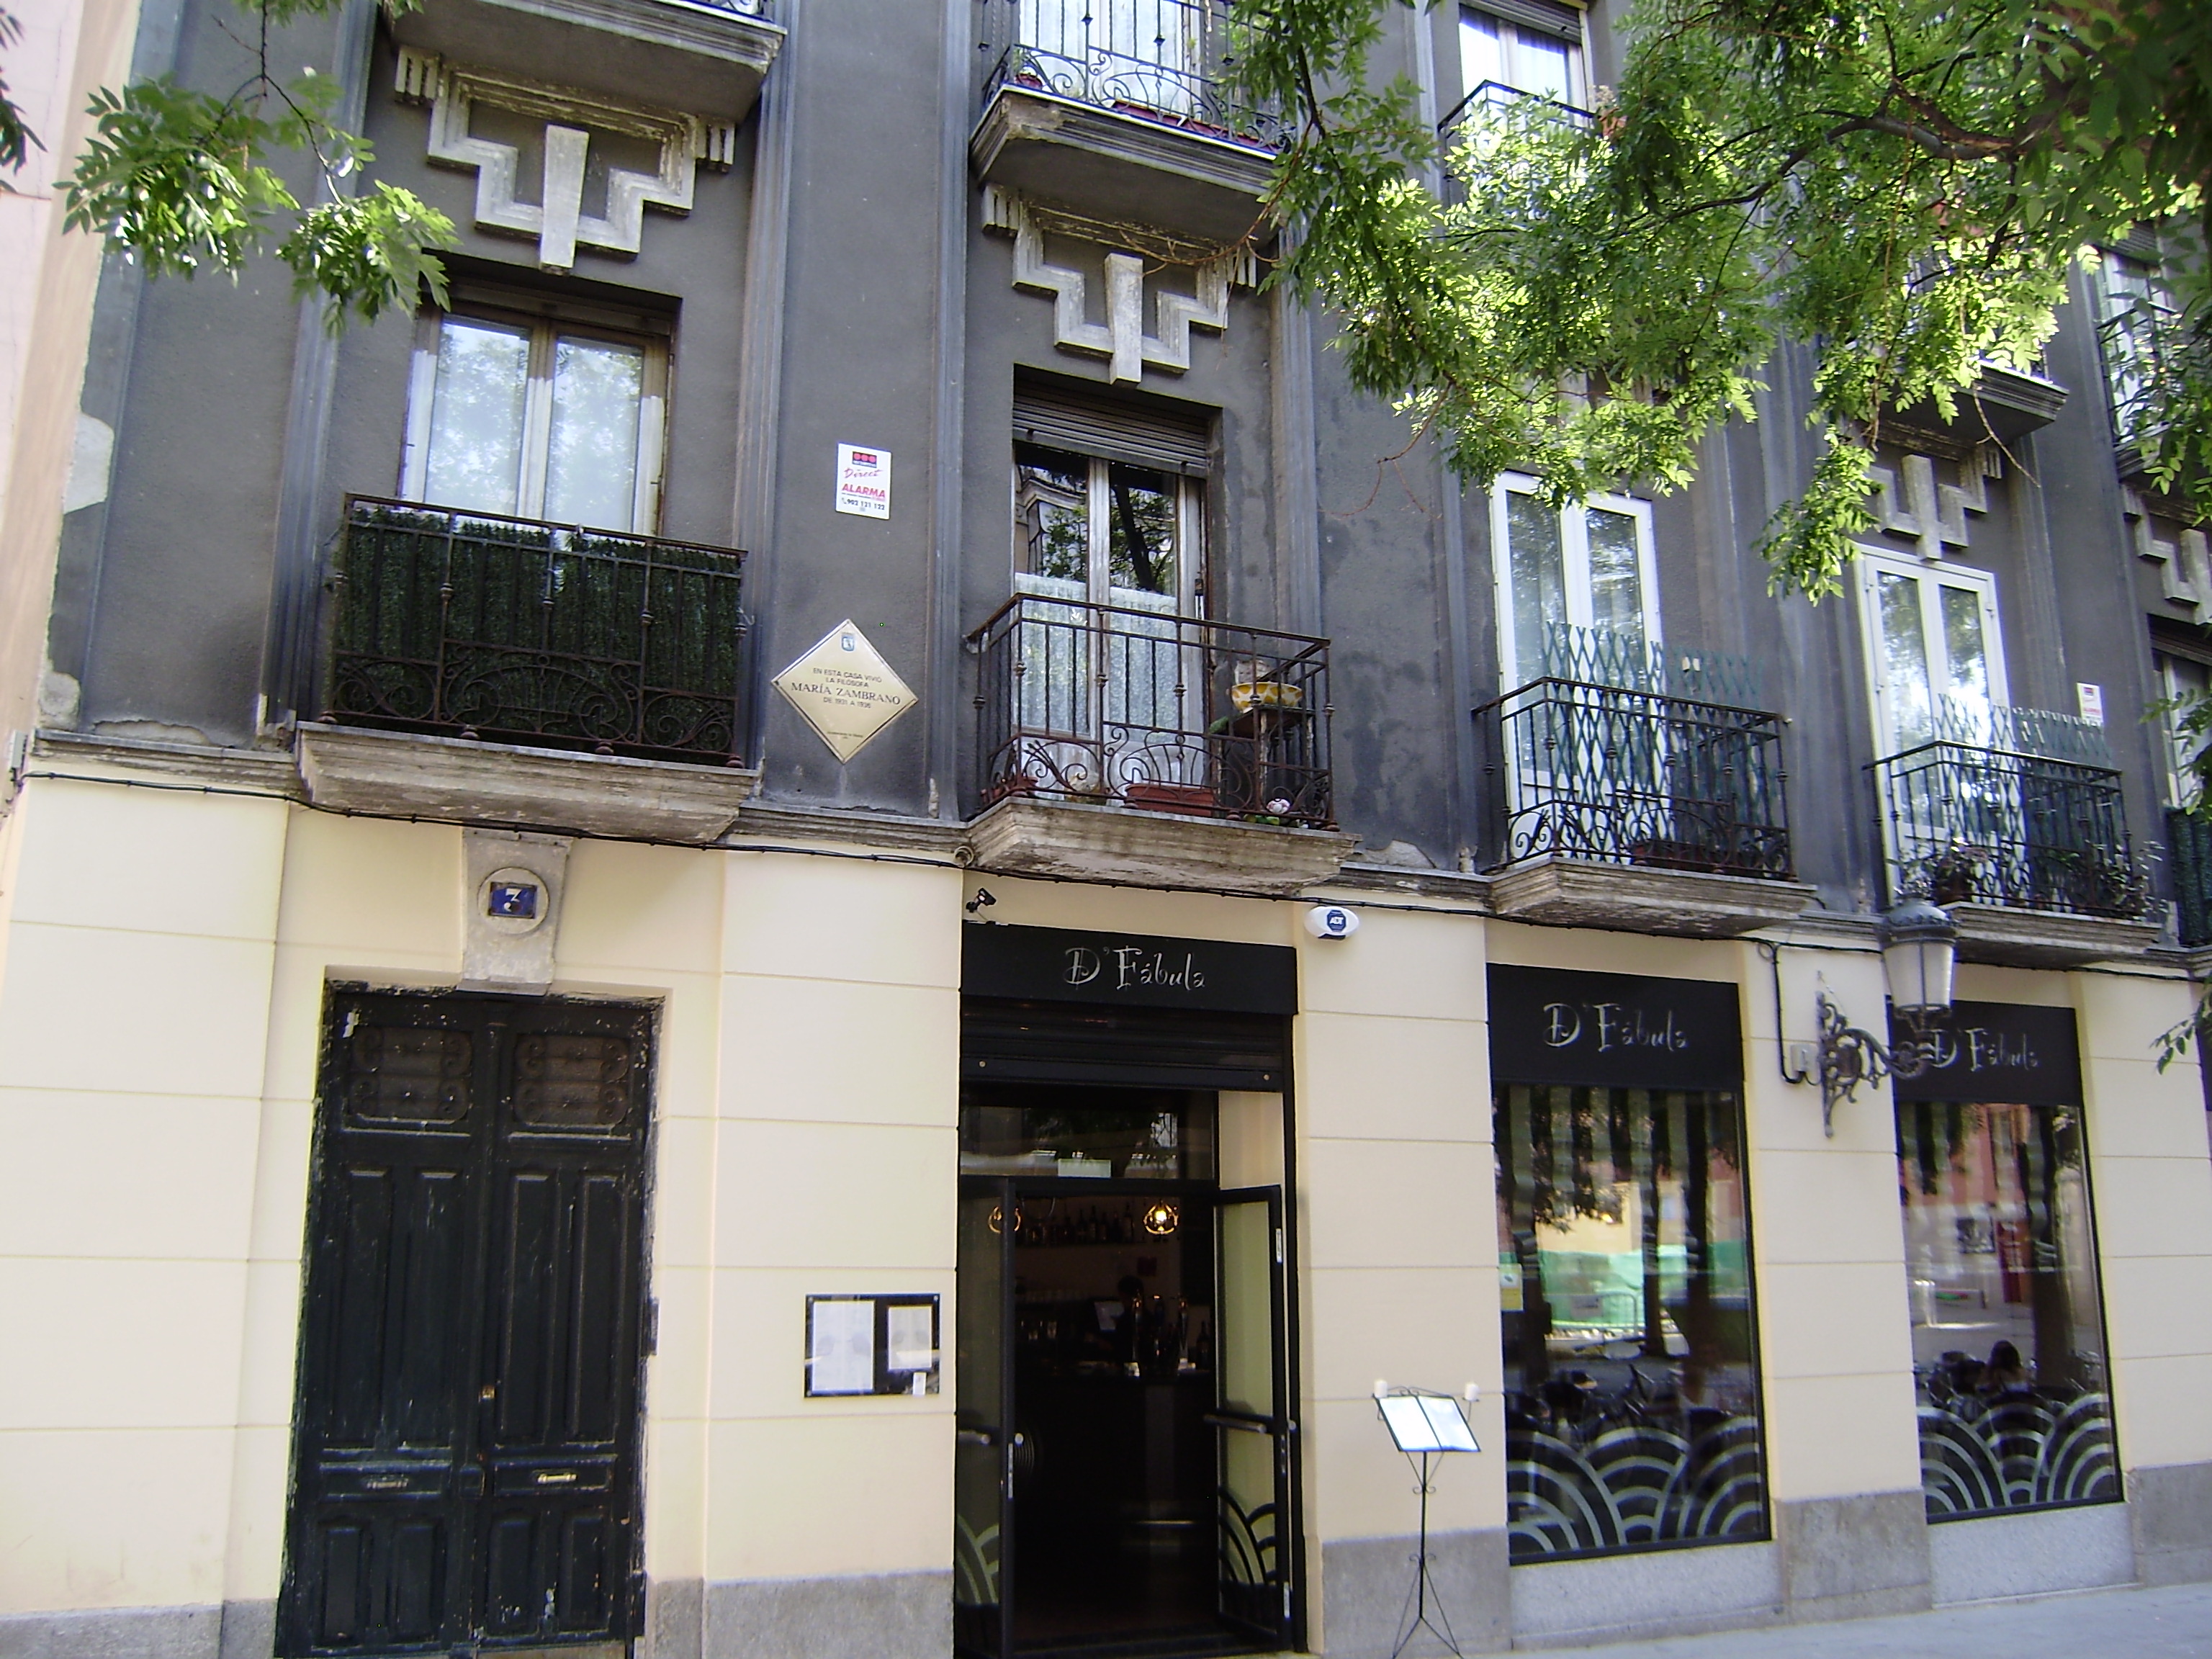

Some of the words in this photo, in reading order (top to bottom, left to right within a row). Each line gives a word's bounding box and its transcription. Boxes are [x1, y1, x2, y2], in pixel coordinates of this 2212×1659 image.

[842, 483, 886, 498] ALARMA
[791, 682, 832, 696] MARÍA
[835, 687, 901, 706] ZAMBRANO
